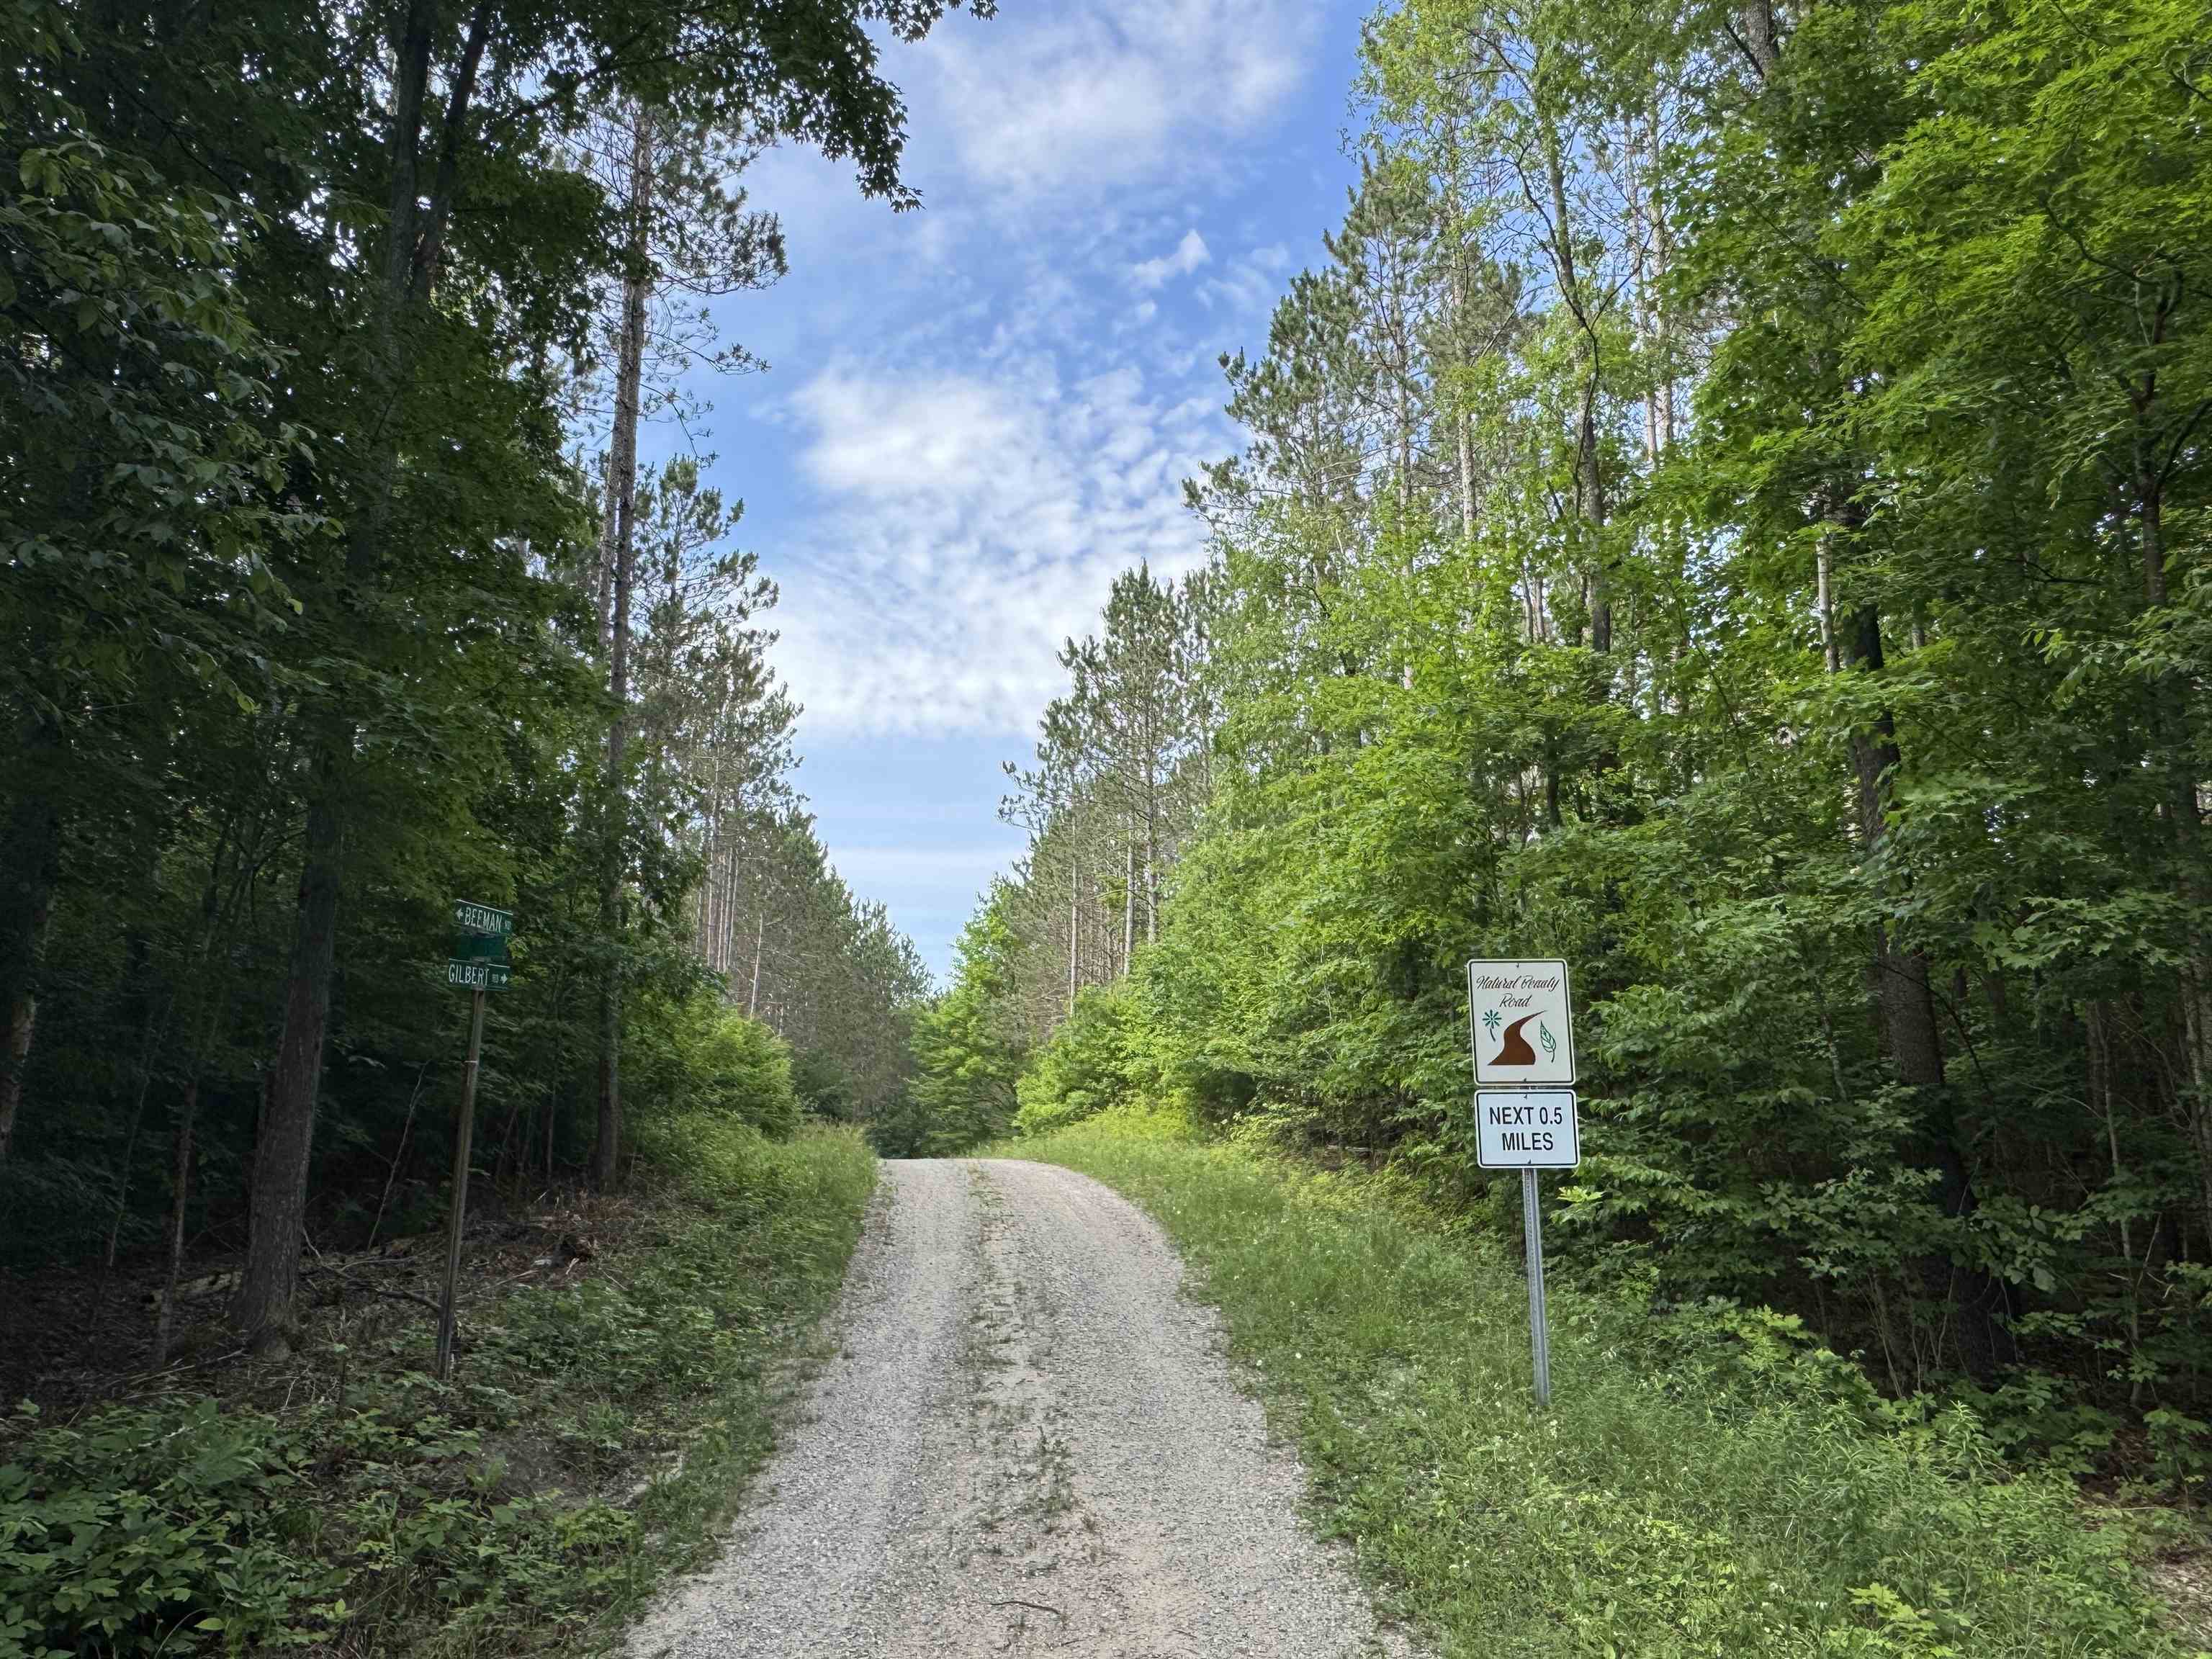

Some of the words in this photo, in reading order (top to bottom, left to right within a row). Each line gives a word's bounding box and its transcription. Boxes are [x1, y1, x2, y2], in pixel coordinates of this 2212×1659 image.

[464, 907, 502, 933] BEEMAN
[449, 963, 490, 985] GILBERT
[1476, 975, 1521, 990] Natural
[1521, 975, 1560, 992] Beauty
[1499, 993, 1532, 1008] Road
[1489, 1107, 1534, 1125] NEXT
[1539, 1107, 1563, 1125] 0.5
[1502, 1133, 1553, 1151] MILES
